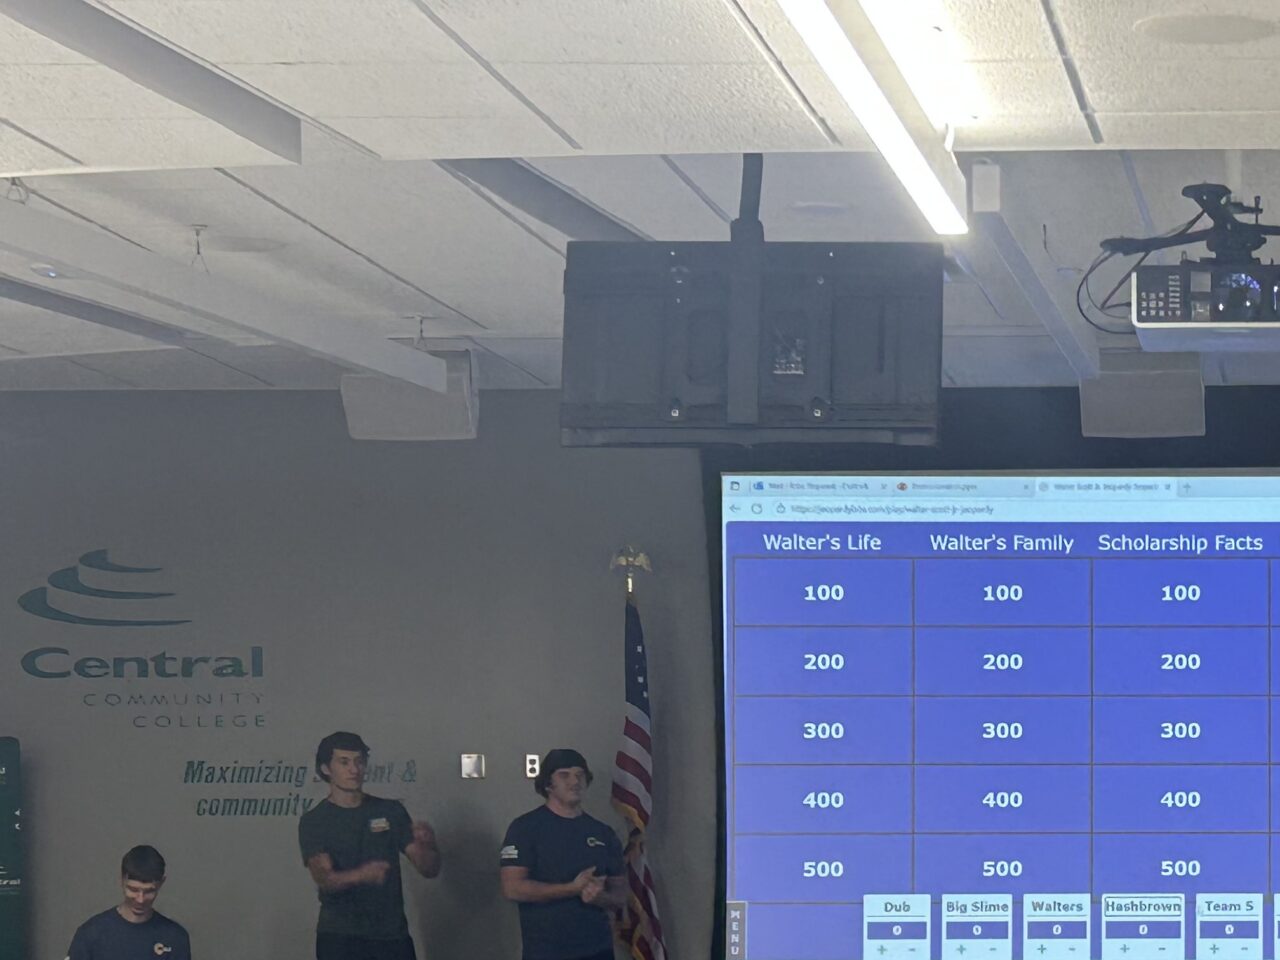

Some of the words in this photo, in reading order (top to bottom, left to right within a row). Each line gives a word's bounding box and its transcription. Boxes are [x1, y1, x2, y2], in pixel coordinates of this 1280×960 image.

[762, 533, 841, 551] Walter's
[847, 533, 882, 551] Life
[929, 533, 1007, 551] Walter's
[1013, 534, 1075, 555] Family
[1098, 533, 1208, 555] Scholarship
[1215, 534, 1264, 551] Facts
[804, 584, 845, 601] 100
[983, 584, 1023, 601] 100
[1161, 584, 1201, 601] 100
[20, 646, 264, 679] Central
[804, 653, 845, 670] 200
[983, 653, 1023, 670] 200
[1161, 653, 1201, 670] 200
[82, 693, 265, 706] COMMUNITY
[132, 714, 265, 728] COLLEGE
[803, 722, 844, 739] 300
[982, 722, 1023, 739] 300
[1160, 722, 1201, 739] 300
[183, 759, 307, 787] Maximizing
[196, 792, 314, 817] community
[802, 791, 844, 809] 400
[982, 791, 1023, 808] 400
[1160, 791, 1201, 808] 400
[803, 861, 844, 878] 500
[982, 860, 1023, 877] 500
[1160, 860, 1201, 876] 500
[883, 900, 911, 913] Dub
[946, 900, 968, 914] Big
[971, 900, 1009, 913] Slime
[1031, 900, 1084, 913] Walters
[1105, 900, 1182, 912] Hashbrown
[1204, 900, 1242, 912] Team
[1245, 900, 1255, 912] 5
[892, 925, 902, 936] 0
[972, 924, 982, 936] 0
[1052, 924, 1062, 935] 0
[1138, 924, 1148, 935] 0
[1224, 924, 1235, 935] 0
